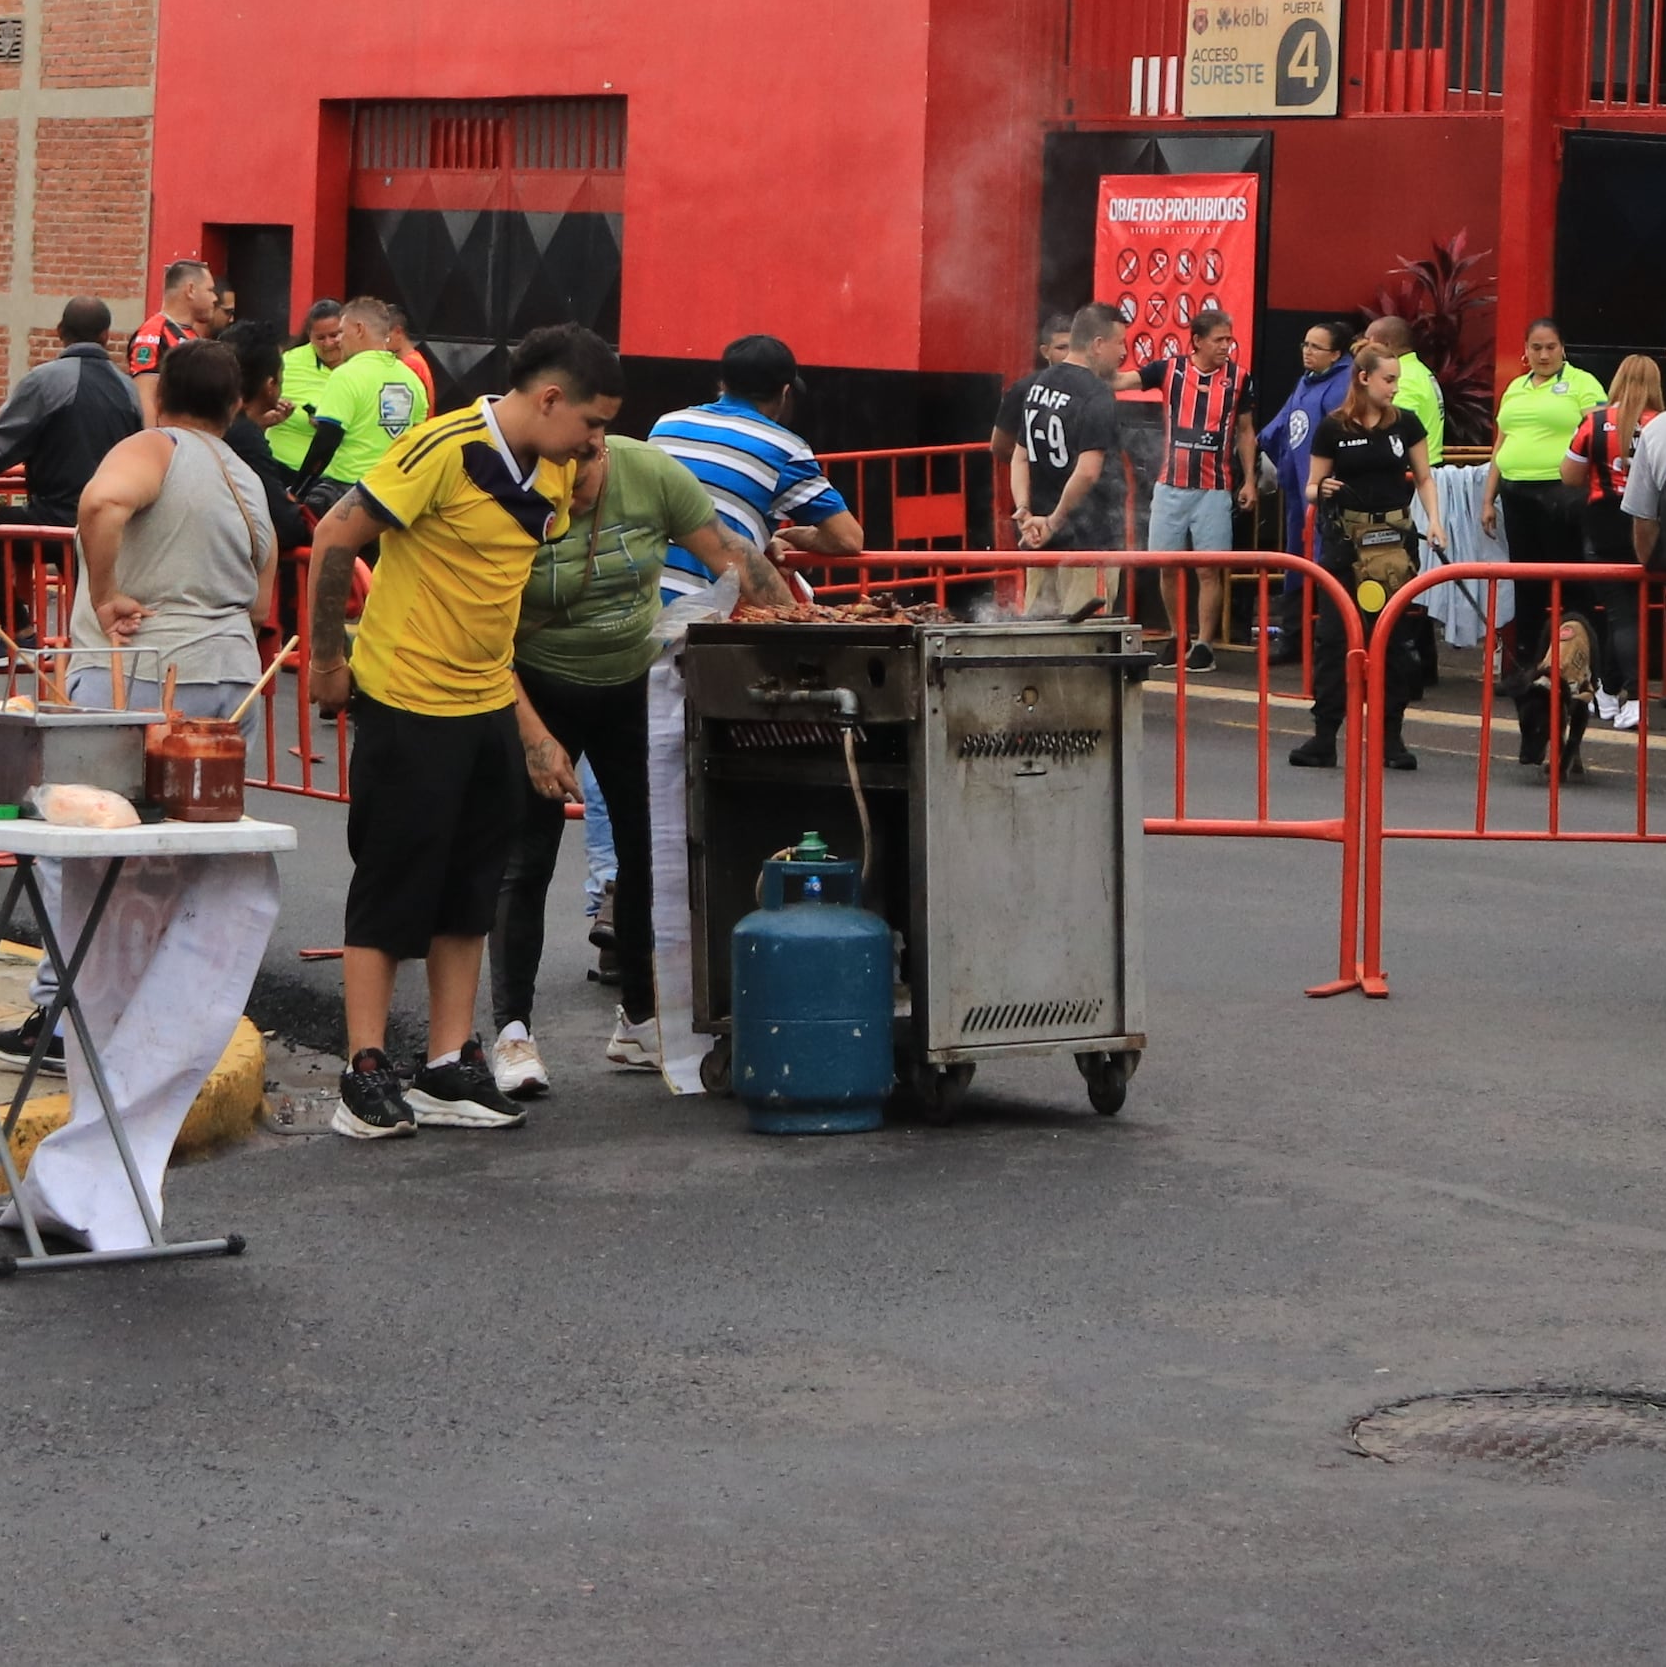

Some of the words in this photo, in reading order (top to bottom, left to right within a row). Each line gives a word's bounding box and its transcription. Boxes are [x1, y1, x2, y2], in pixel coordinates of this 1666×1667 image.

[1233, 6, 1269, 27] kölbi
[1283, 2, 1324, 14] PUERTA
[1192, 48, 1238, 62] ACCESO
[1288, 31, 1319, 88] 4
[1190, 64, 1264, 85] SURESTE
[1109, 197, 1164, 222] OBJETOS
[1164, 196, 1247, 222] PROHIBIDOS
[1027, 384, 1071, 410] STAFF
